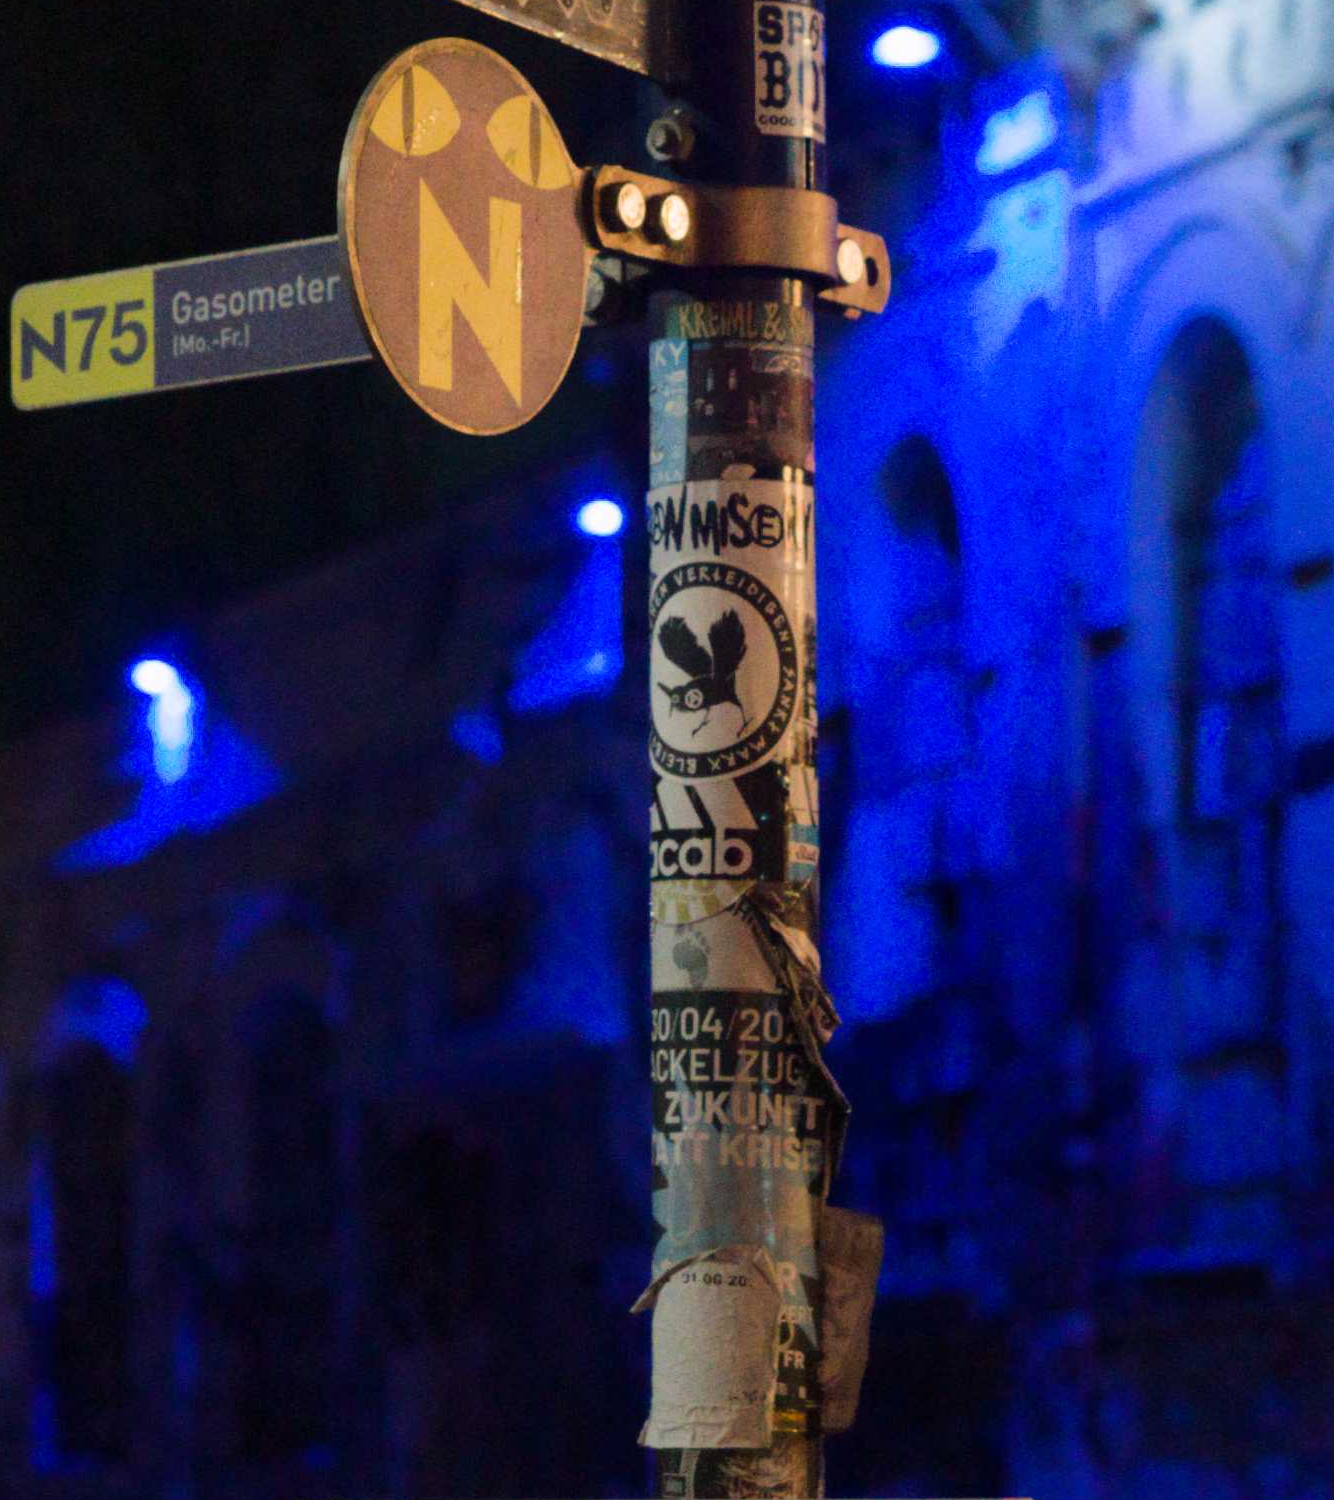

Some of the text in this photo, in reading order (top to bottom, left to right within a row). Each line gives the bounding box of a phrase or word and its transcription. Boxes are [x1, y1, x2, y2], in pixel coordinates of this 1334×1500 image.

[20, 275, 340, 381] N75 Gasometer
[420, 177, 521, 407] N
[664, 1090, 825, 1131] ZUKUNFT
[719, 1133, 825, 1172] KRISE
